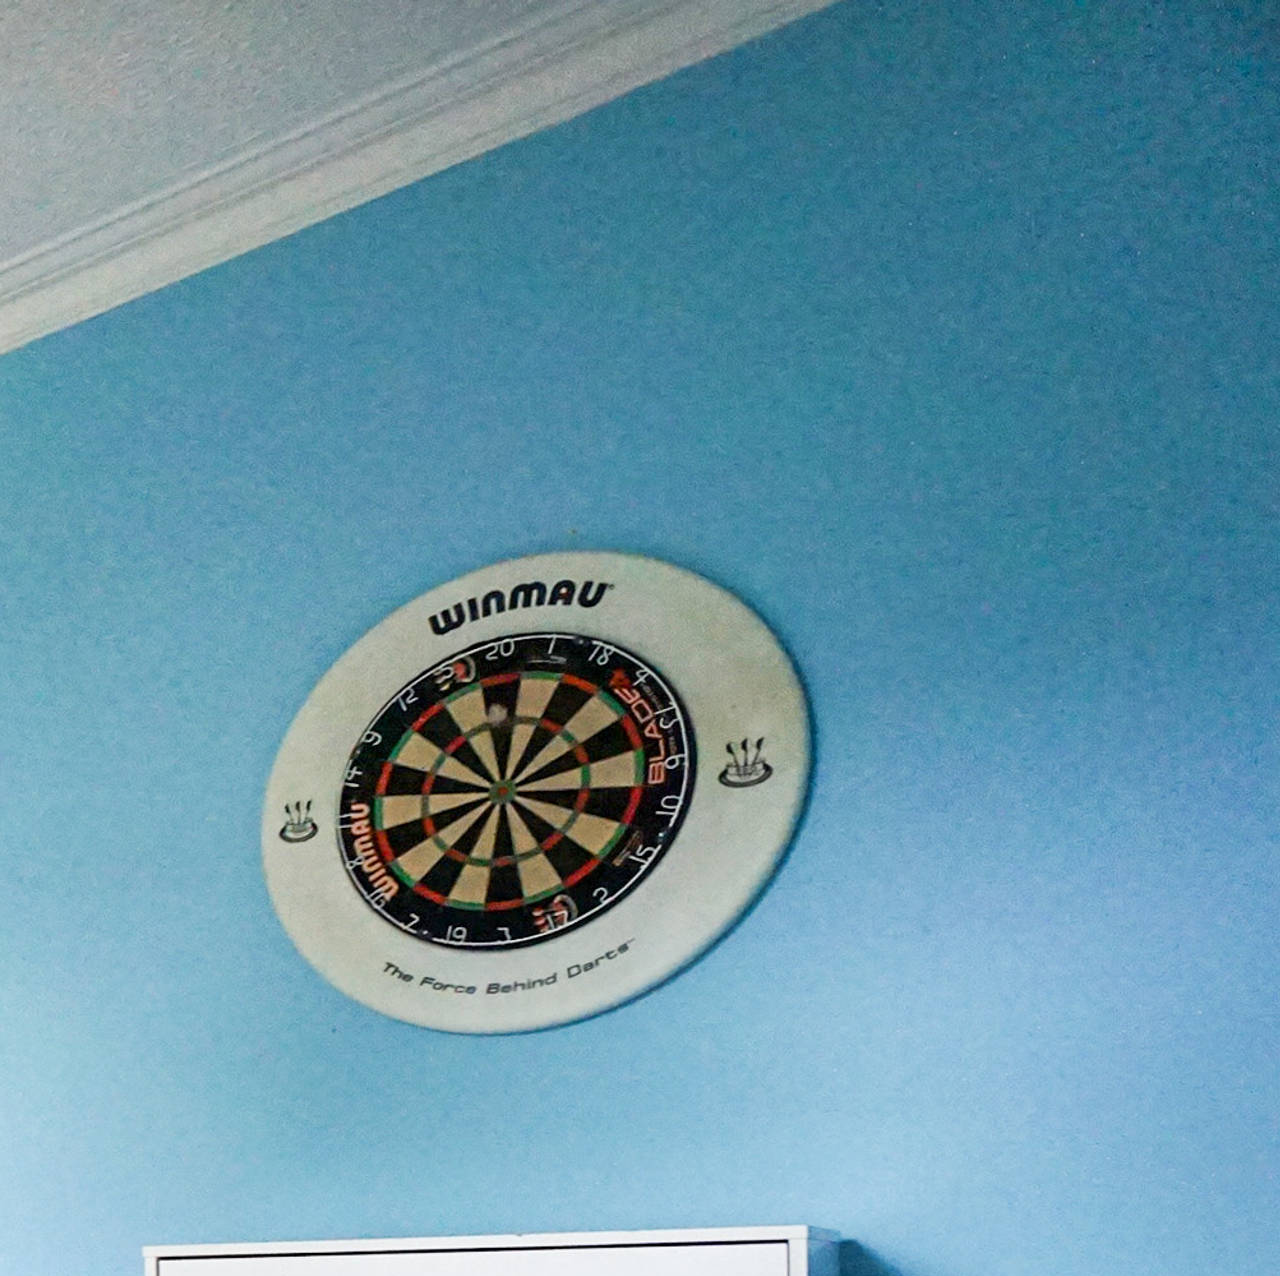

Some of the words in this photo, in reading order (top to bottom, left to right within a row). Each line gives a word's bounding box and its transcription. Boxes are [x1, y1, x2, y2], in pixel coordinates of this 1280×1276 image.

[428, 579, 609, 636] WINMAU
[485, 639, 515, 661] 20
[587, 645, 614, 666] 18
[397, 687, 419, 711] 12
[664, 754, 686, 769] 6
[655, 795, 683, 817] 10
[628, 843, 658, 867] 15
[446, 925, 468, 943] 19
[382, 962, 415, 983] The
[420, 976, 478, 995] Force
[485, 972, 559, 995] Behind
[567, 943, 630, 979] Darts
